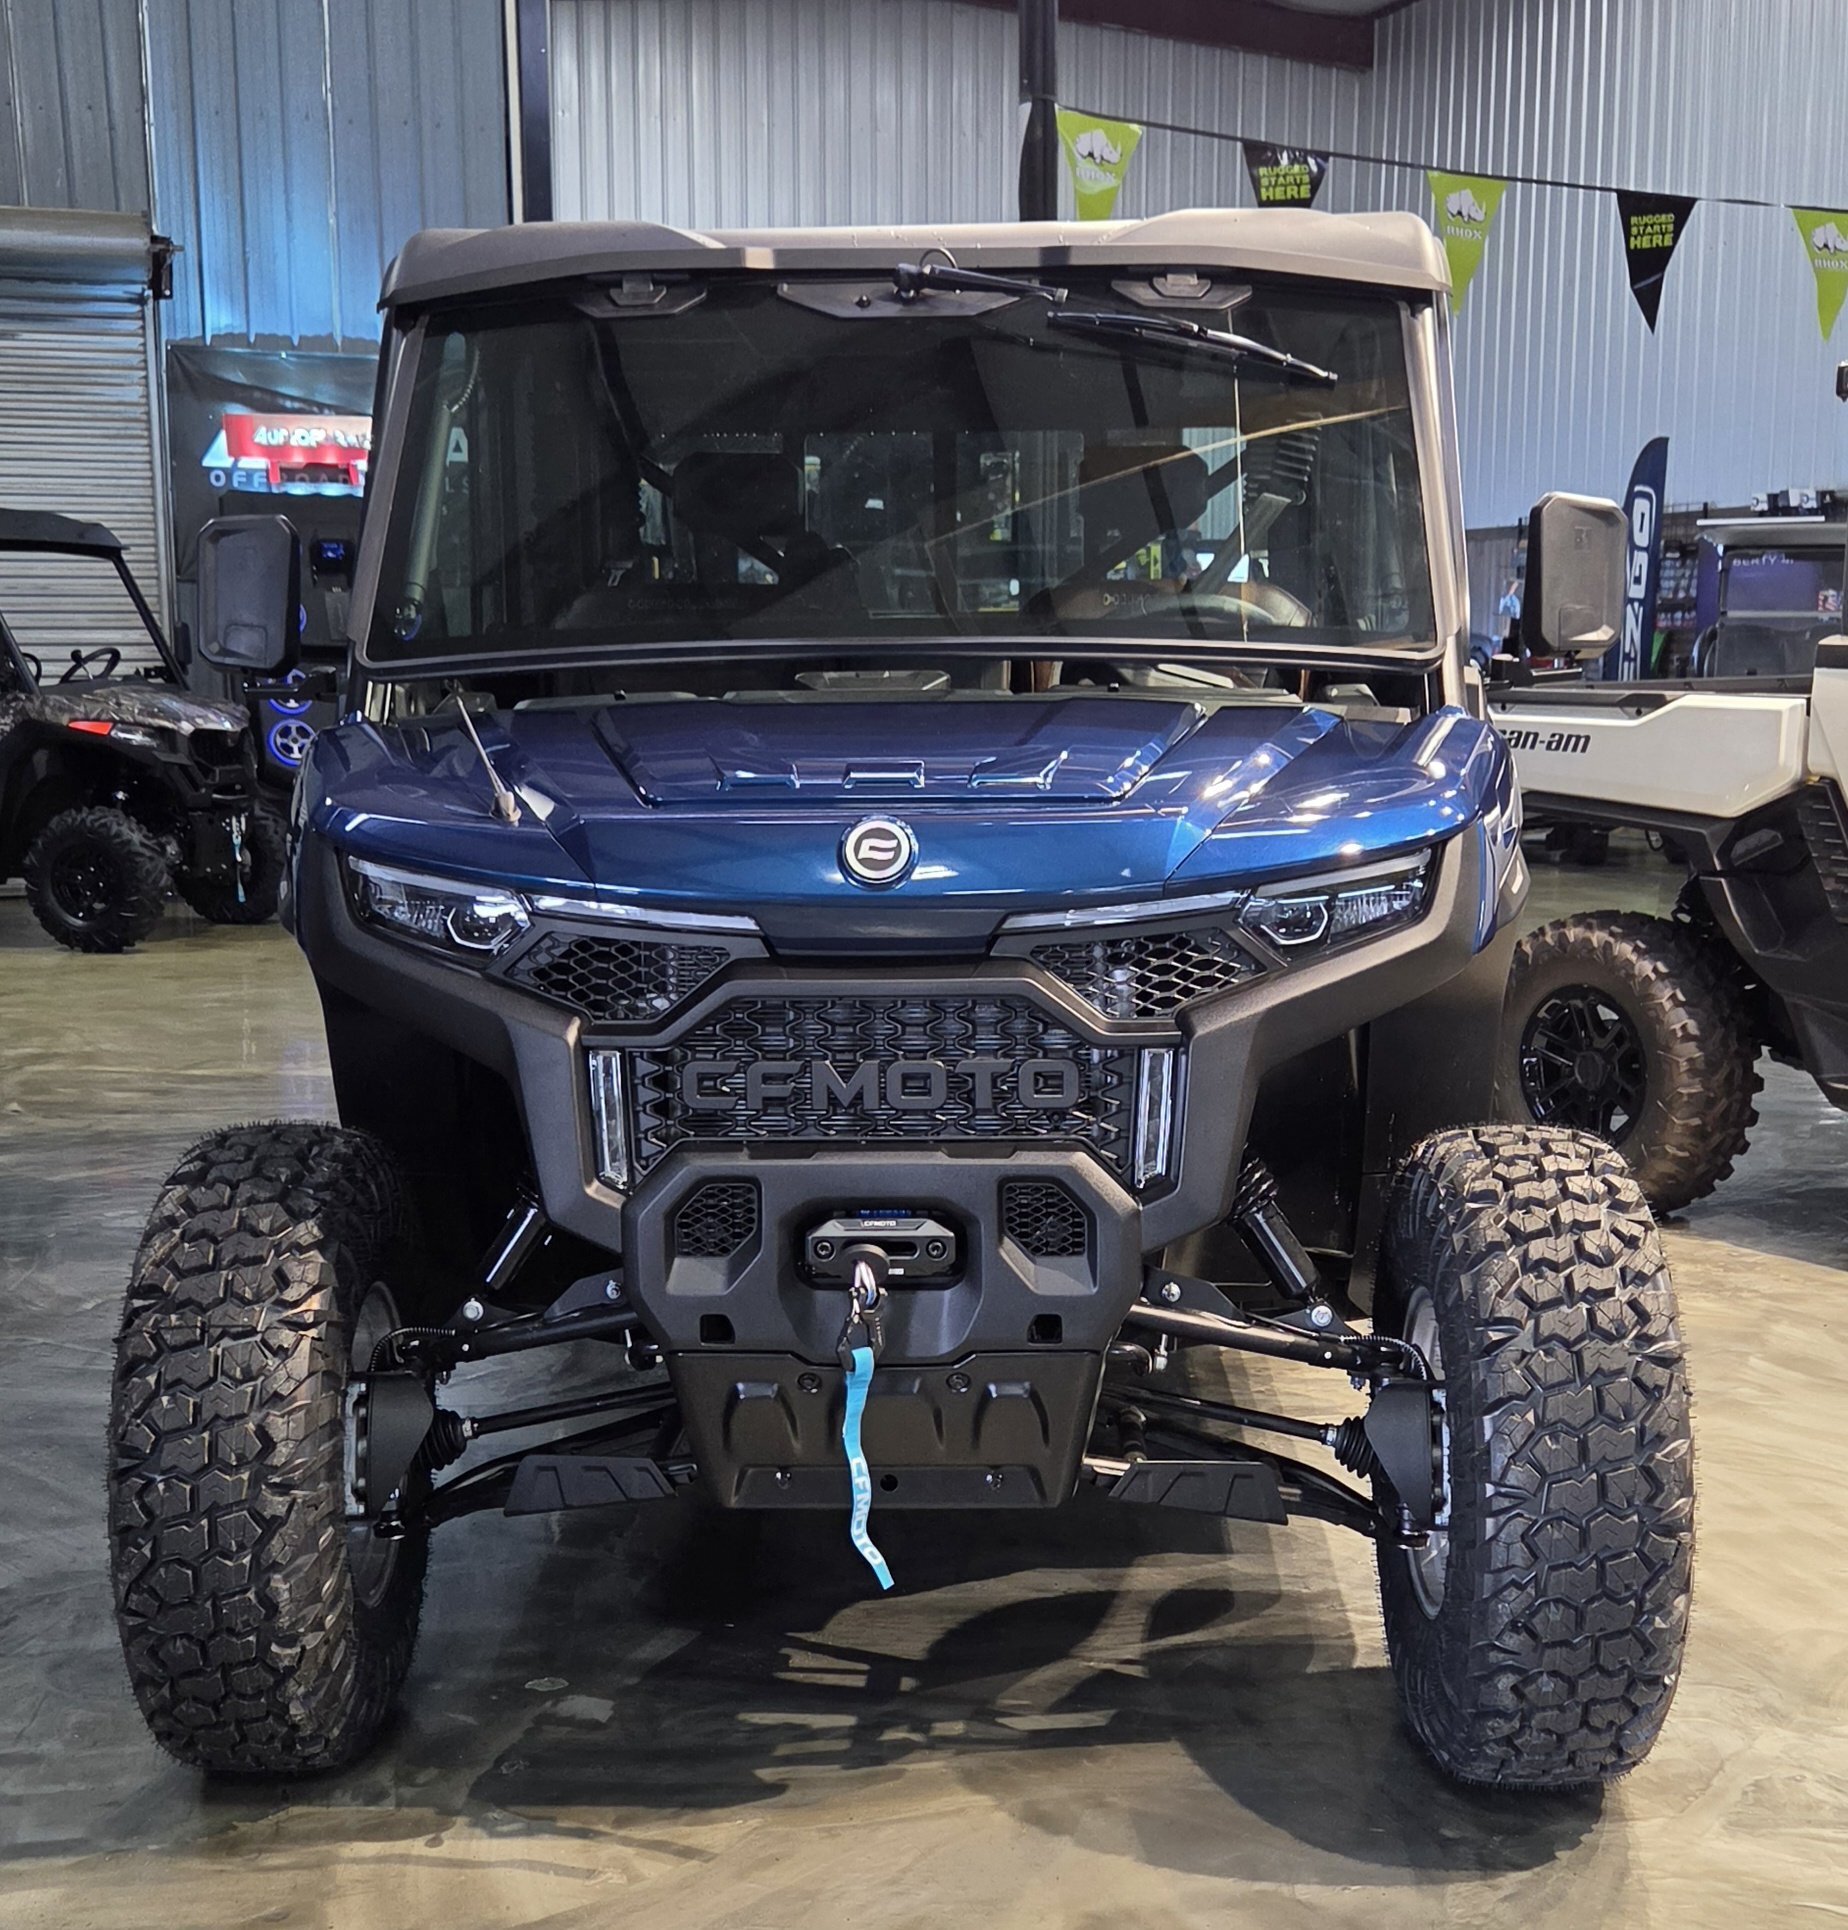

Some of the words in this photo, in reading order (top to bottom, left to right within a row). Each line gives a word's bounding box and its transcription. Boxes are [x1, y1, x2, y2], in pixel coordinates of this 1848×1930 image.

[1259, 164, 1310, 177] RUGGED
[1261, 174, 1311, 187] STARTS
[1261, 184, 1312, 201] HERE
[1630, 213, 1675, 226] RUGGED
[1446, 224, 1483, 240] RHOX
[1630, 223, 1674, 236] STARTS
[1629, 233, 1674, 250] HERE
[209, 469, 267, 488] OFF
[1498, 728, 1591, 754] an-am
[681, 1058, 1081, 1110] CFMOTO
[863, 1219, 897, 1228] CFMOTO
[850, 1457, 884, 1566] CFMOTO
